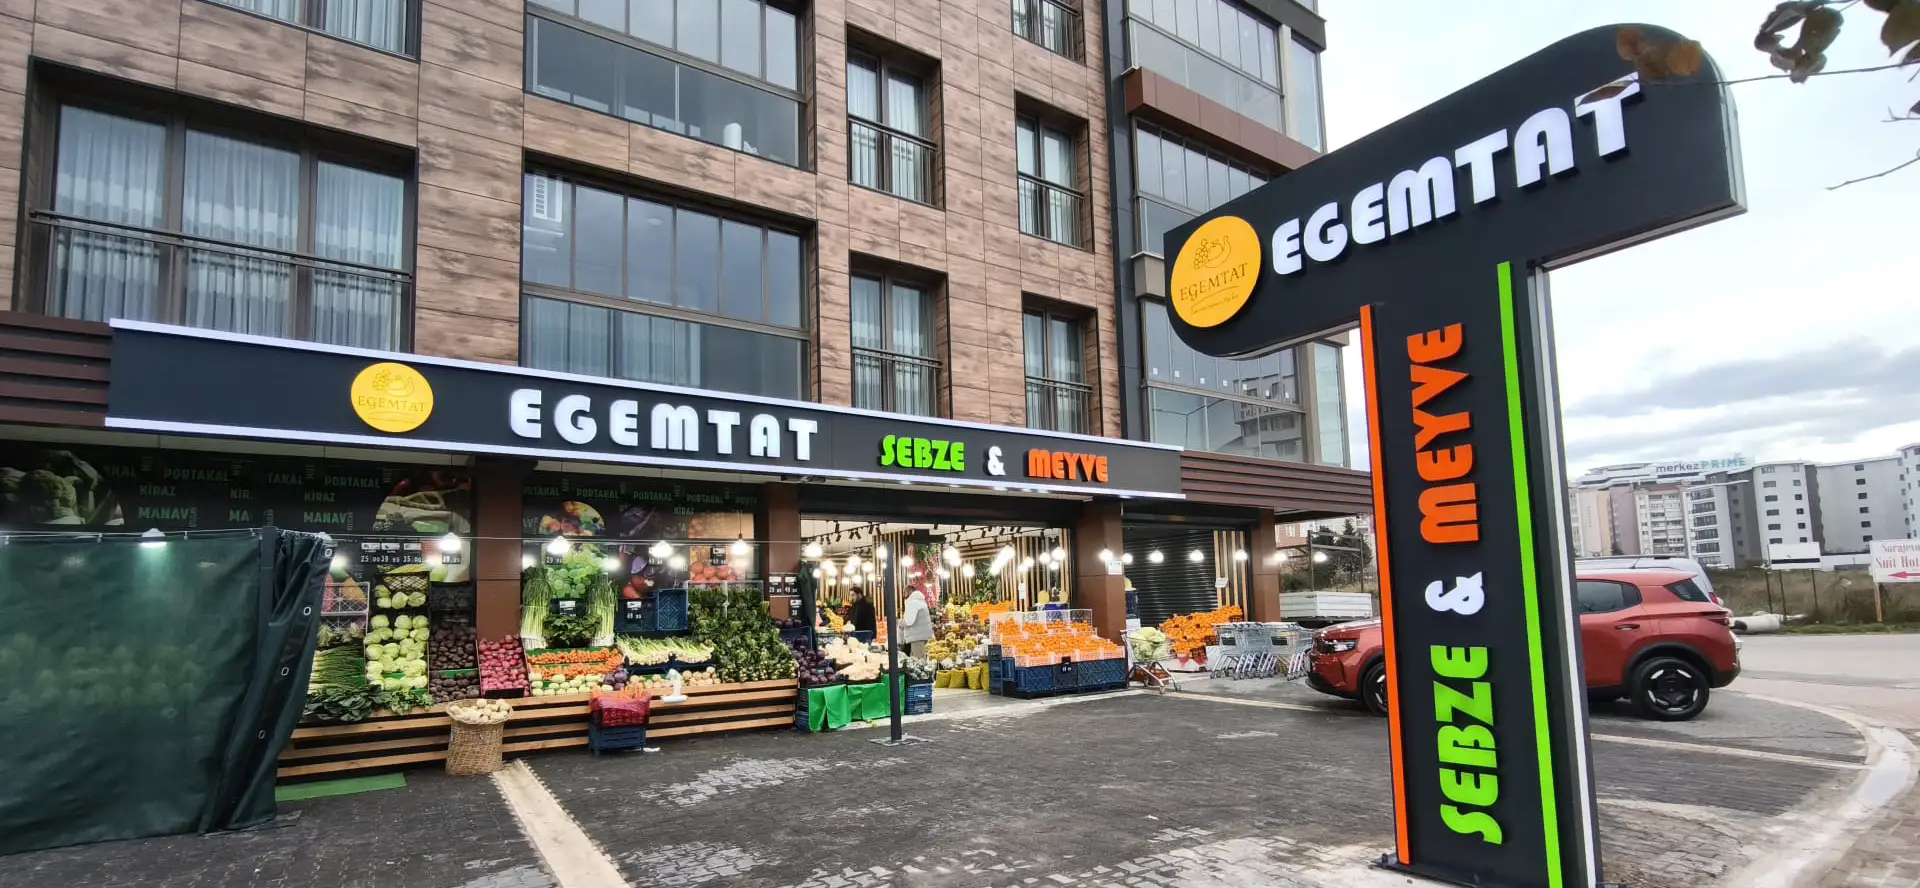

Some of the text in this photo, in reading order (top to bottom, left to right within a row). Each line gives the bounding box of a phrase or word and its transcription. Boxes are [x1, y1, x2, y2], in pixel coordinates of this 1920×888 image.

[1272, 71, 1641, 276] EGEMTAT
[1179, 262, 1249, 303] EGEMTAT
[358, 395, 425, 412] EGEMTAT
[510, 388, 818, 461] EGEMTAT
[164, 466, 230, 482] PORTAKAL
[880, 434, 1109, 483] SEBZE & MEYVE
[324, 474, 380, 489] PORTAKAL
[1407, 322, 1503, 845] SEBZE & MEYVE
